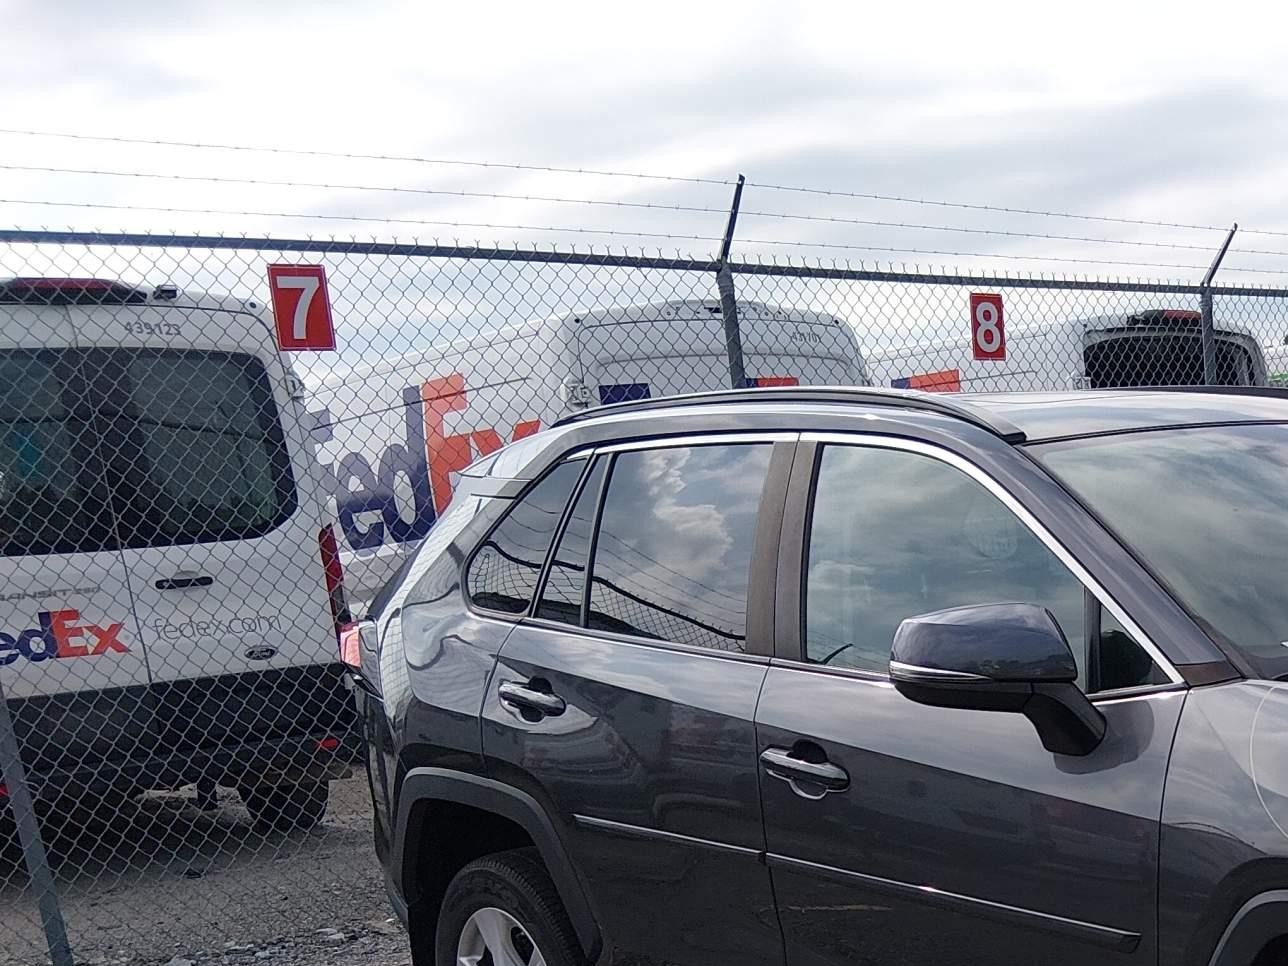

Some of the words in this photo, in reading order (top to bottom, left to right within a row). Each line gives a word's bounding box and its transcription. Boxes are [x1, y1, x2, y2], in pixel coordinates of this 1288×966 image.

[276, 276, 320, 340] 7
[125, 321, 181, 336] 439123
[976, 302, 1000, 353] 8
[152, 615, 282, 640] fedex.com
